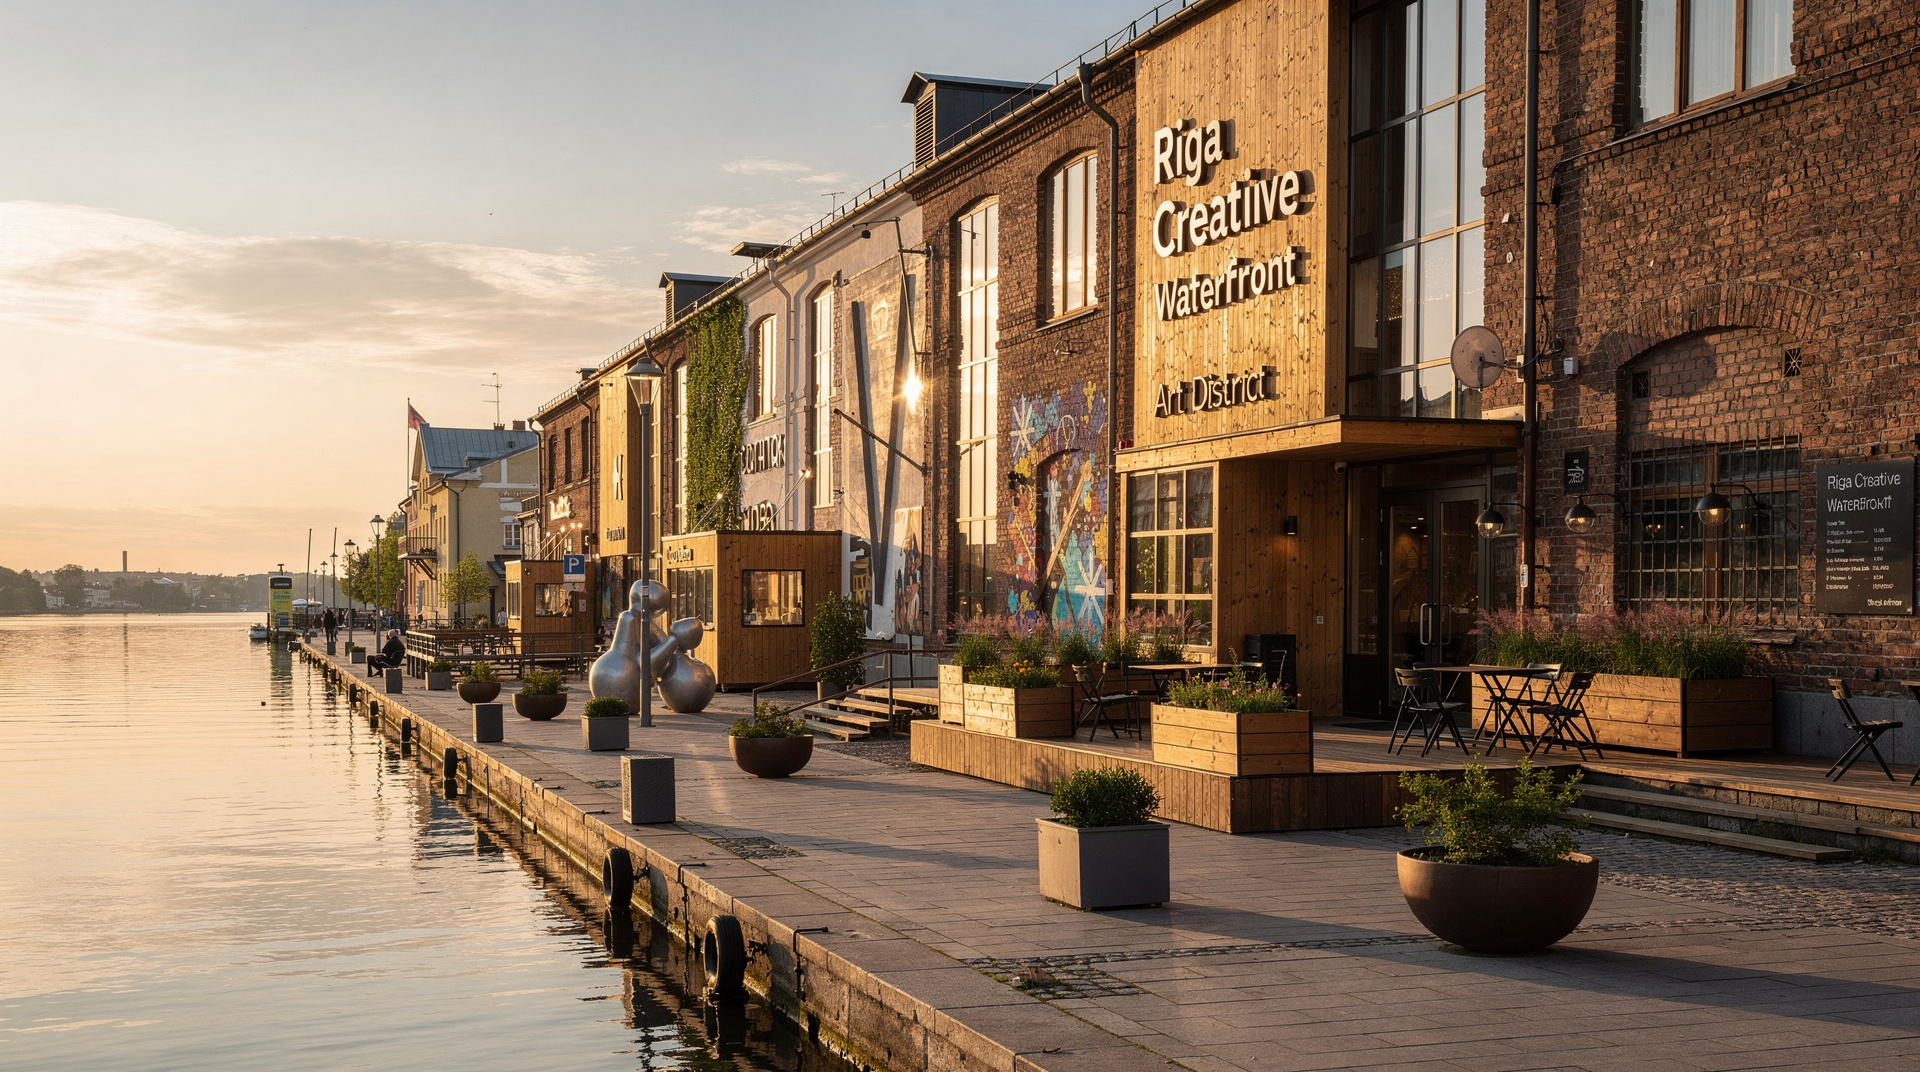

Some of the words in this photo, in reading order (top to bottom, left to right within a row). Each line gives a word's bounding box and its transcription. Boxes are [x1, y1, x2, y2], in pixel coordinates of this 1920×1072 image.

[1154, 118, 1223, 187] Riga
[1154, 246, 1297, 322] Waterfront
[1155, 383, 1185, 418] Art
[1193, 364, 1265, 412] District
[1827, 474, 1853, 491] Riga
[1854, 472, 1901, 488] Creative
[569, 557, 580, 573] P
